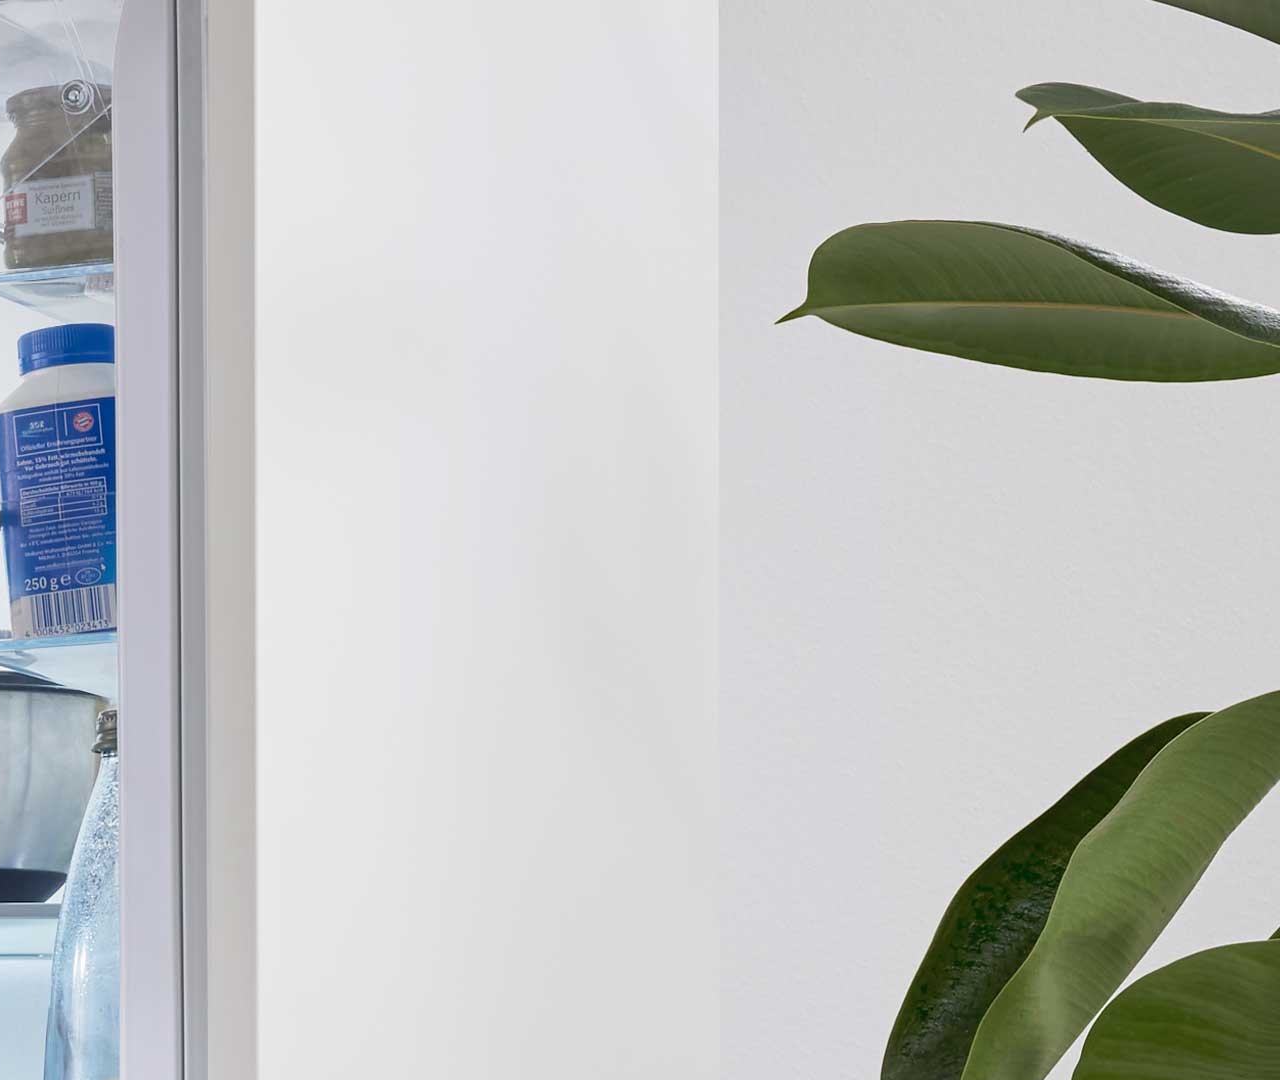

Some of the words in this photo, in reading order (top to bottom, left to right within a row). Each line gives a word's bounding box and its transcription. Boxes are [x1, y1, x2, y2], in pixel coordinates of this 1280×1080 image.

[35, 191, 81, 205] Kapern
[24, 577, 47, 591] 250
[50, 577, 59, 590] g
